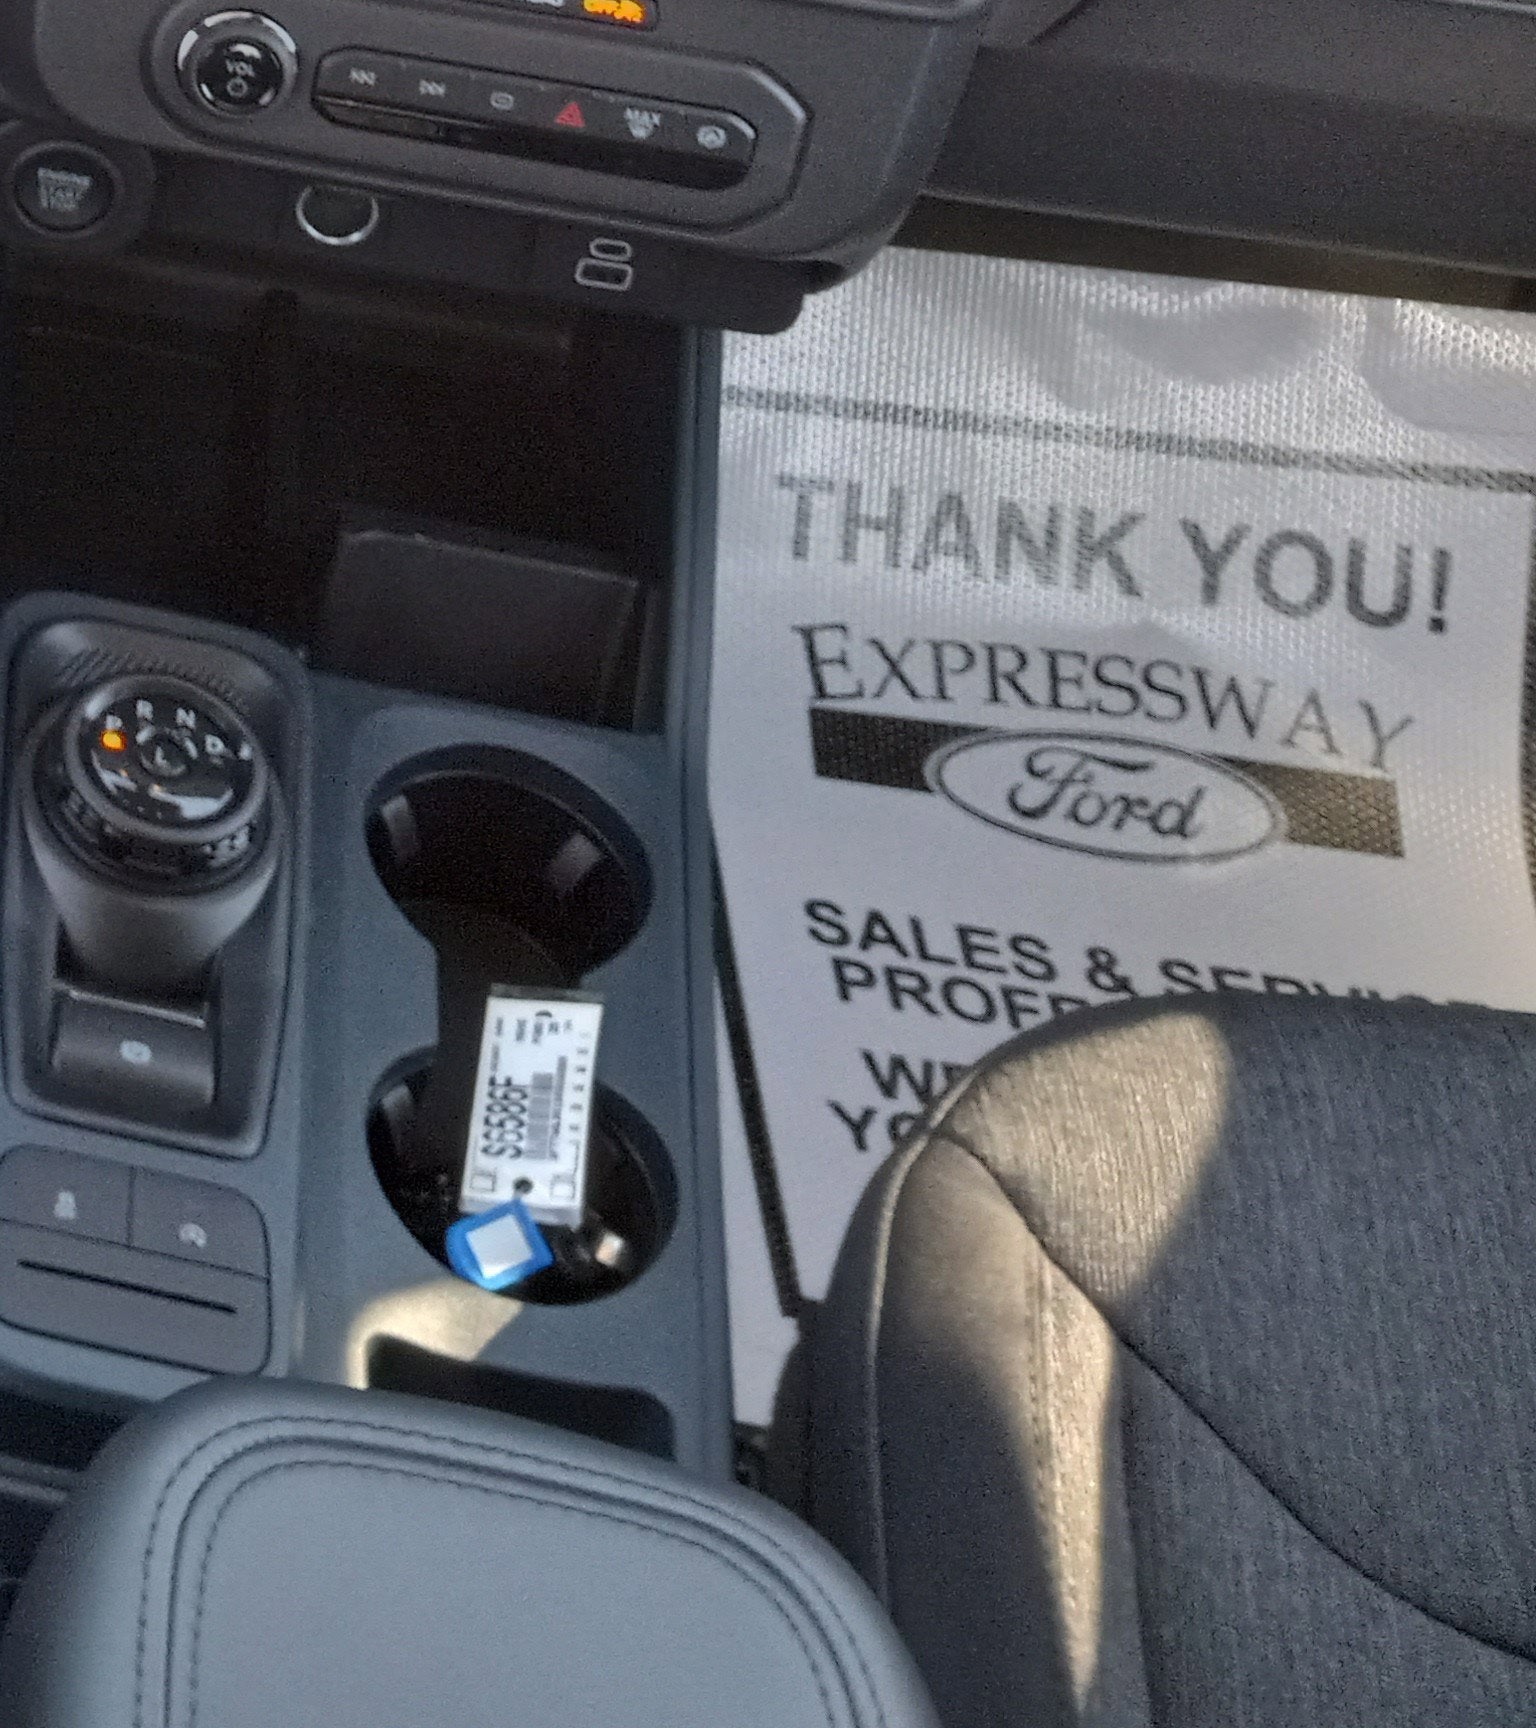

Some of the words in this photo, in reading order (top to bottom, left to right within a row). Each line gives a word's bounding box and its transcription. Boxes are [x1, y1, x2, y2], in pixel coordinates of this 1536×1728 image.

[778, 472, 1145, 599] THANK
[1178, 517, 1455, 635] YOU!
[792, 622, 1416, 776] EXPRESSWAY
[1006, 744, 1202, 840] Ford
[804, 898, 1056, 983] SALES
[1084, 945, 1137, 996] &
